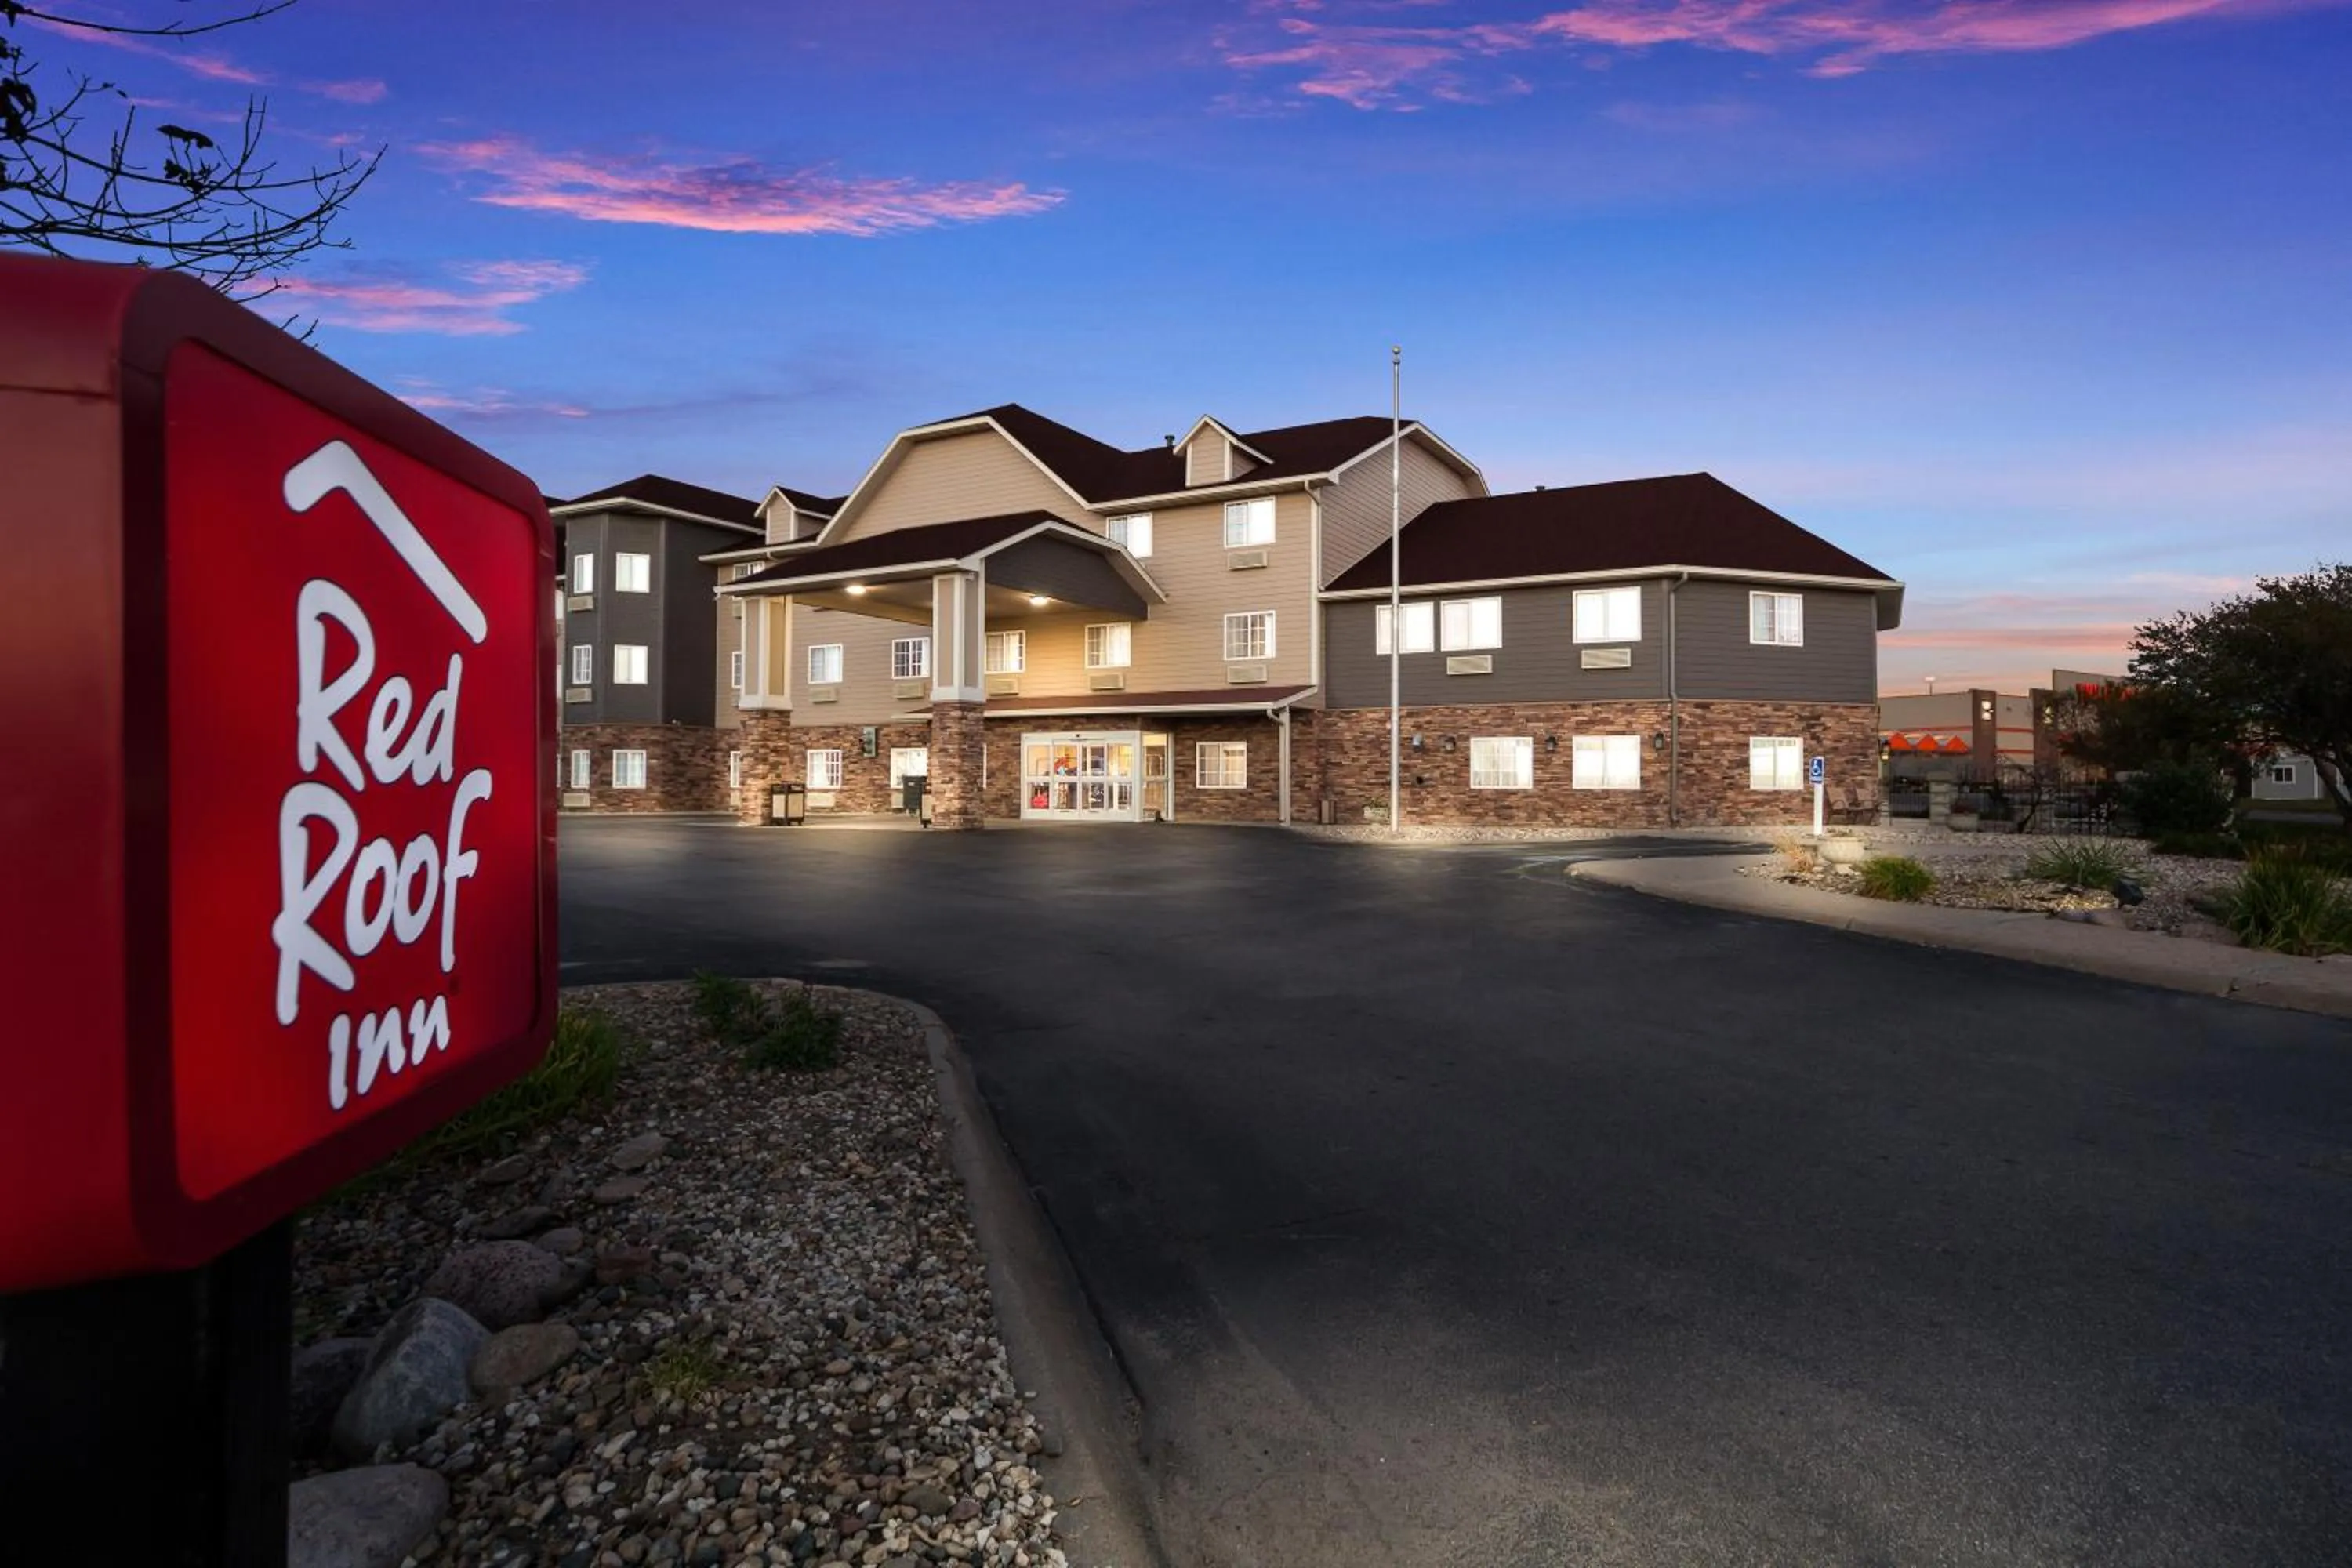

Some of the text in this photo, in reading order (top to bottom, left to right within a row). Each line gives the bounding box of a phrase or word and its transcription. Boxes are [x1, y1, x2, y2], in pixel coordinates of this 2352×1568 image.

[296, 579, 463, 792] Red
[272, 768, 492, 1025] Roof
[329, 995, 451, 1109] Inn
